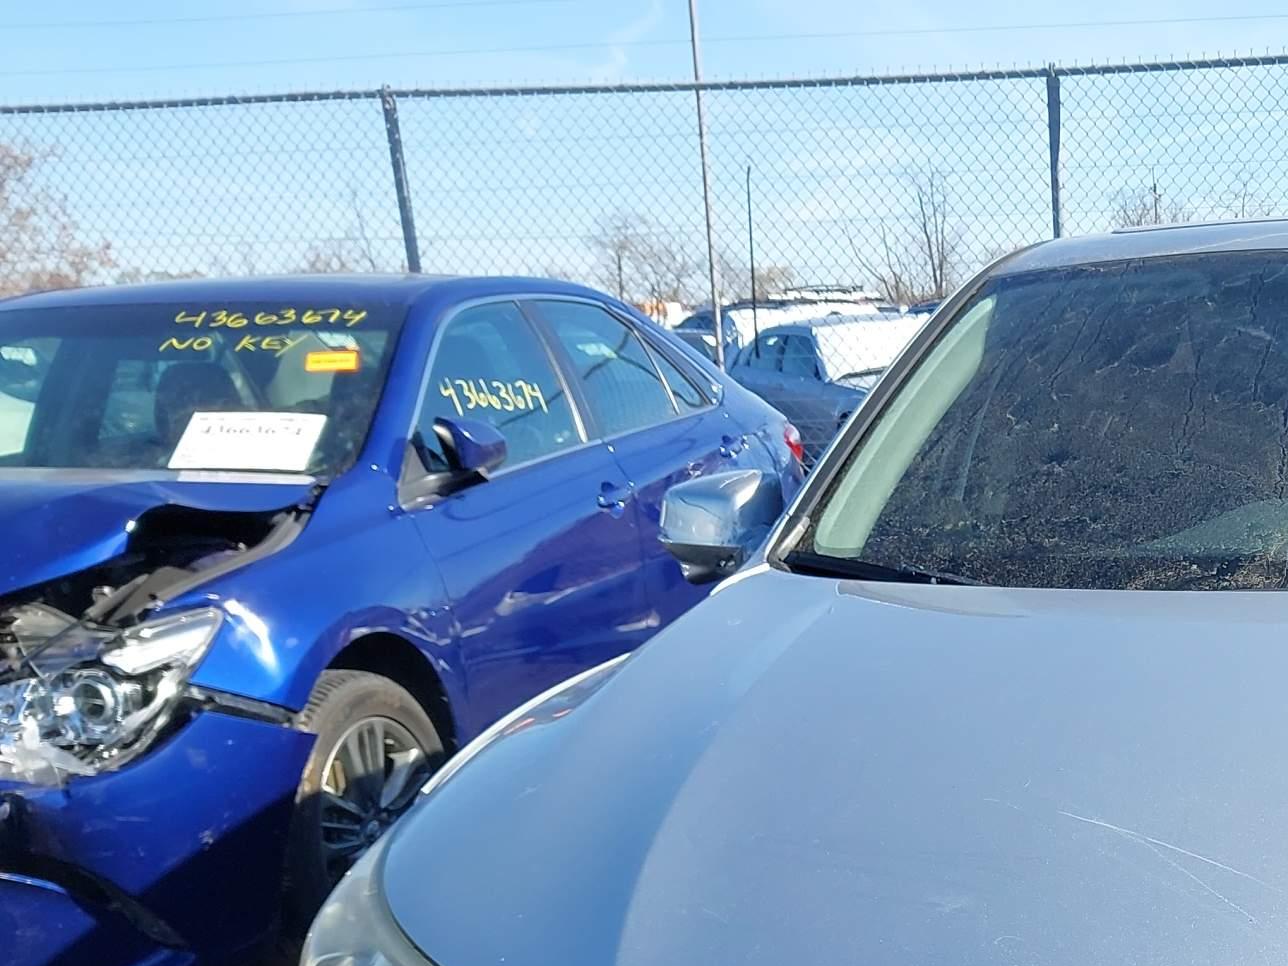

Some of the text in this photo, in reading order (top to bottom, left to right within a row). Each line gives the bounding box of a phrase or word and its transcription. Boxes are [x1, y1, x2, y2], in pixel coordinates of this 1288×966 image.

[175, 308, 367, 328] 43663674
[159, 334, 309, 357] NO KEY
[439, 377, 549, 416] 43663674
